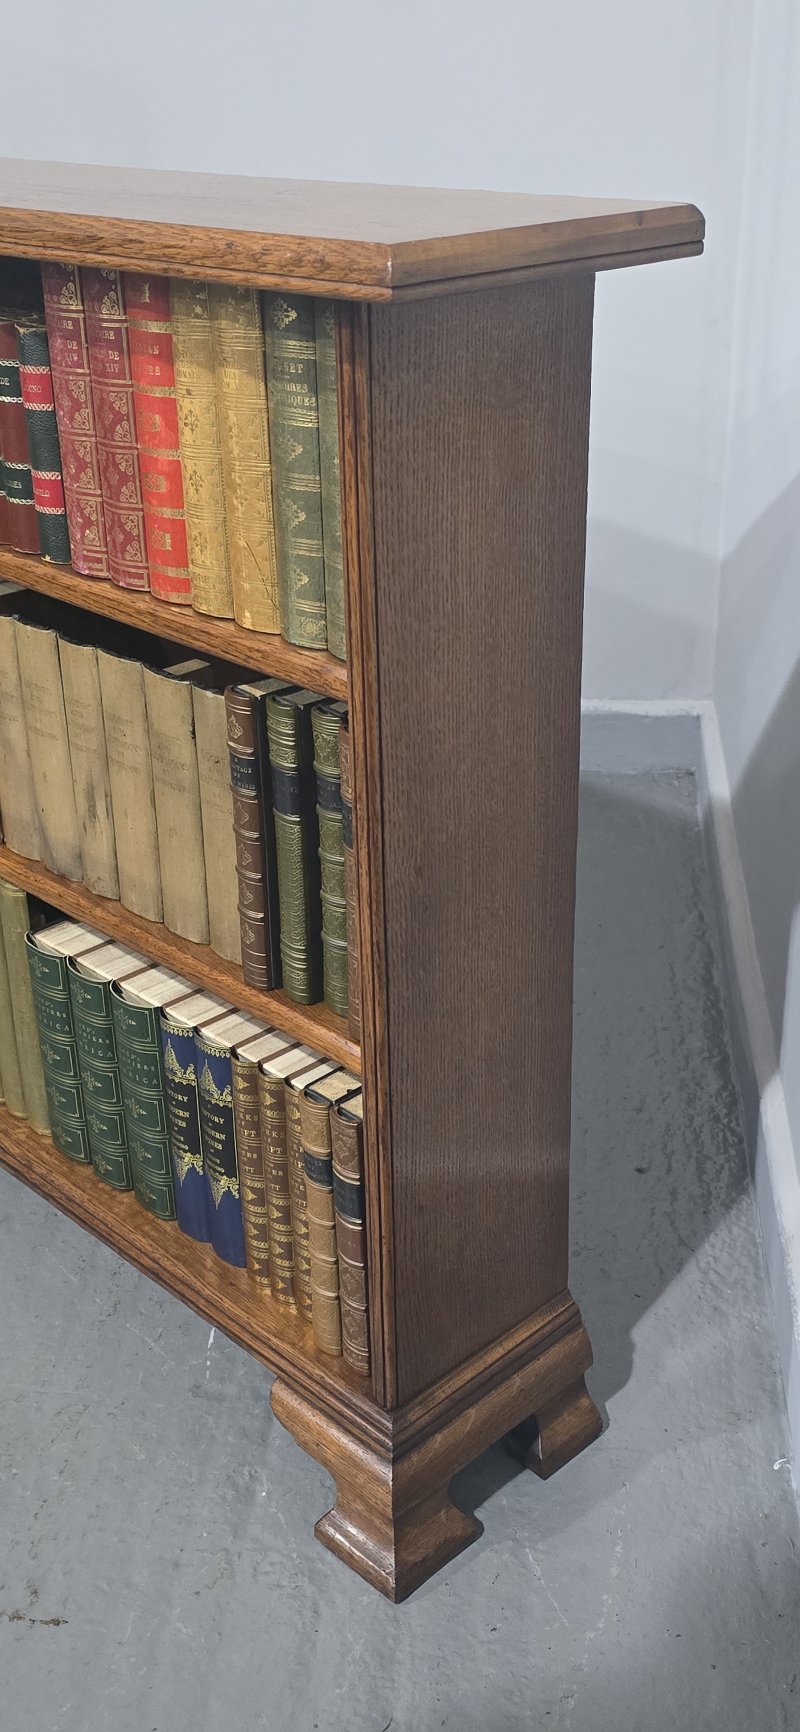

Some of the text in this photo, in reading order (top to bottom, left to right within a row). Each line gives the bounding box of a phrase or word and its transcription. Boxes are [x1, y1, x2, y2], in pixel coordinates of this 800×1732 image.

[67, 340, 78, 350] DE
[108, 351, 120, 360] DE
[105, 363, 119, 372] XIV
